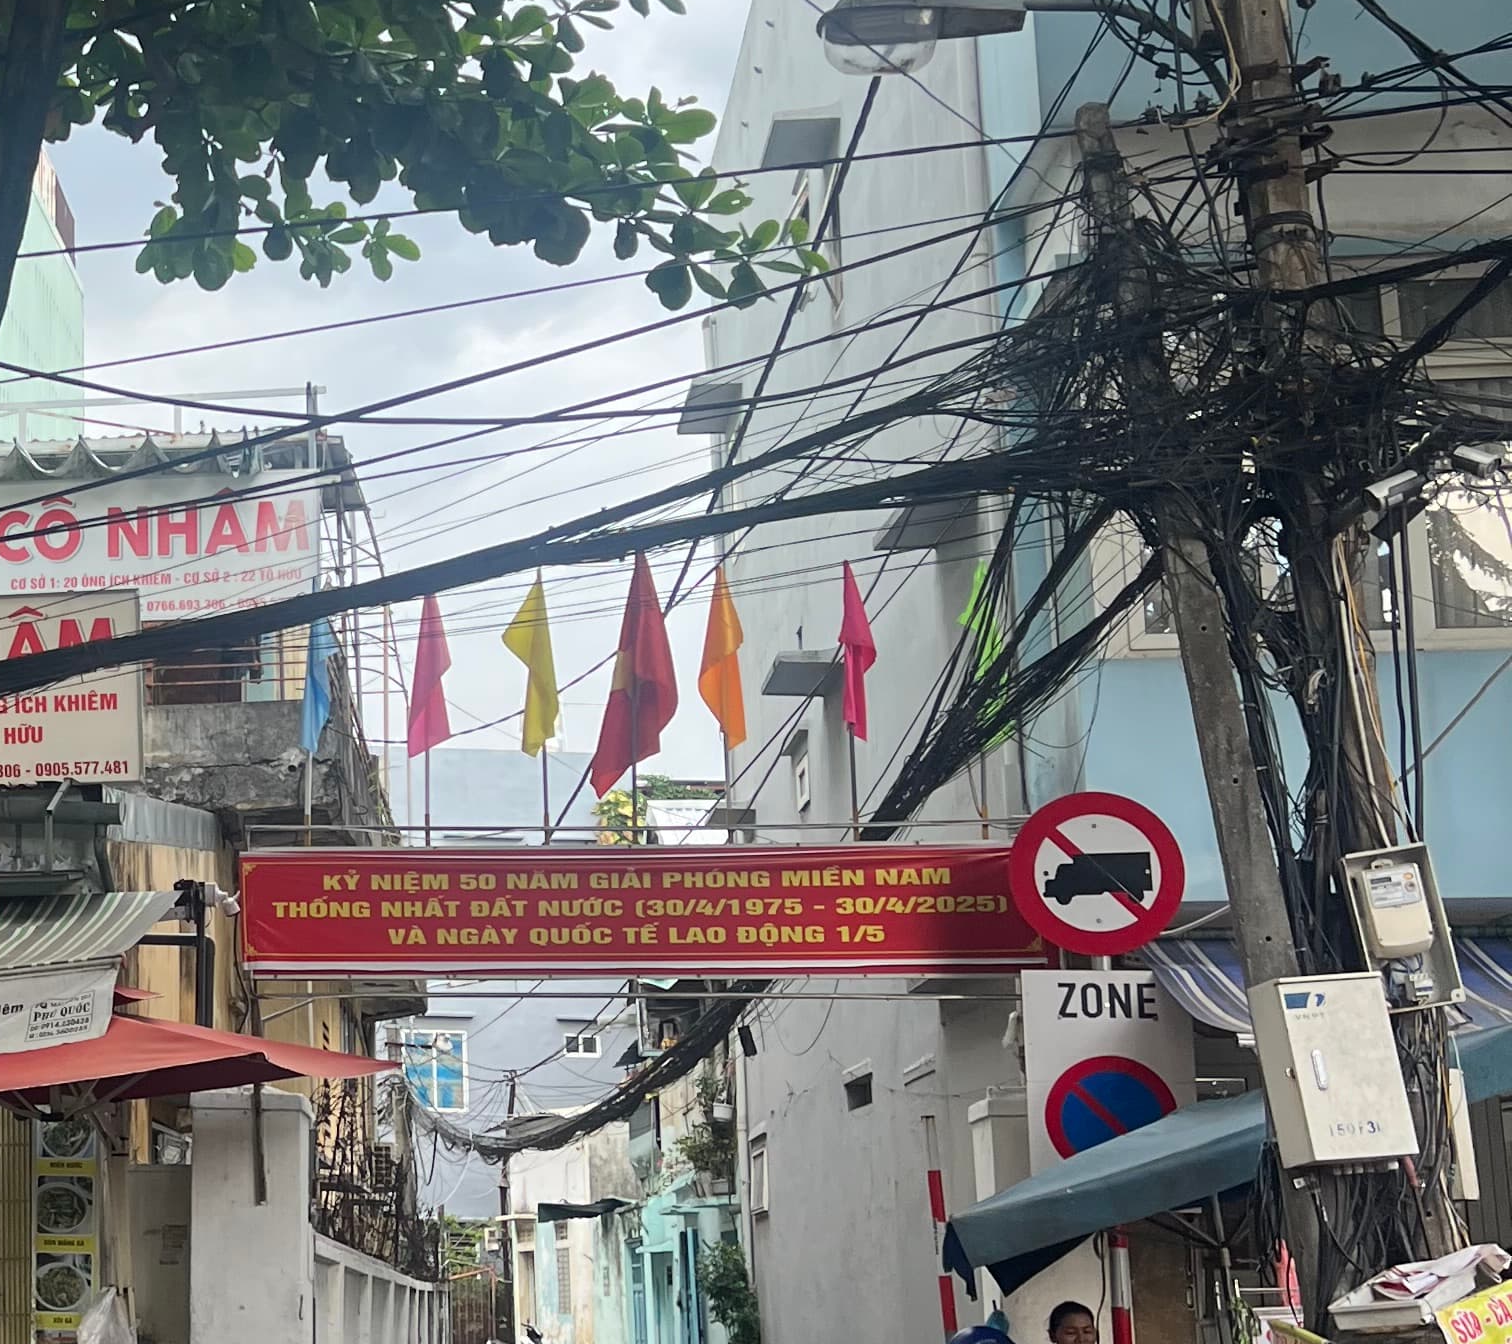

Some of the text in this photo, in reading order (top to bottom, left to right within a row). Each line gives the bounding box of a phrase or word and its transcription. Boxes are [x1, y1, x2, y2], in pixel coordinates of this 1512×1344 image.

[107, 487, 310, 558] NHÂM
[54, 690, 118, 712] KHIÊM
[4, 722, 44, 744] HỮU
[35, 760, 129, 777] 0905.577.481
[371, 871, 449, 894] NIỆM
[460, 873, 497, 890] 50
[507, 869, 578, 889] NĂM
[590, 866, 651, 889] GIẢI
[662, 867, 770, 888] PHÓNG
[781, 864, 864, 887] MIỀN
[875, 867, 951, 886] NAM
[271, 895, 371, 918] THỐNG
[381, 894, 460, 918] NHẤT
[469, 894, 528, 917] ĐẤT
[539, 896, 623, 917] NƯỚC
[635, 897, 803, 918] (30/4/1975
[835, 895, 1008, 915] 30/4/2025)
[388, 921, 885, 947] VÀ NGÀY QUỐC TẾ LAO ĐỘNG 1/5
[1058, 983, 1157, 1020] ZONE
